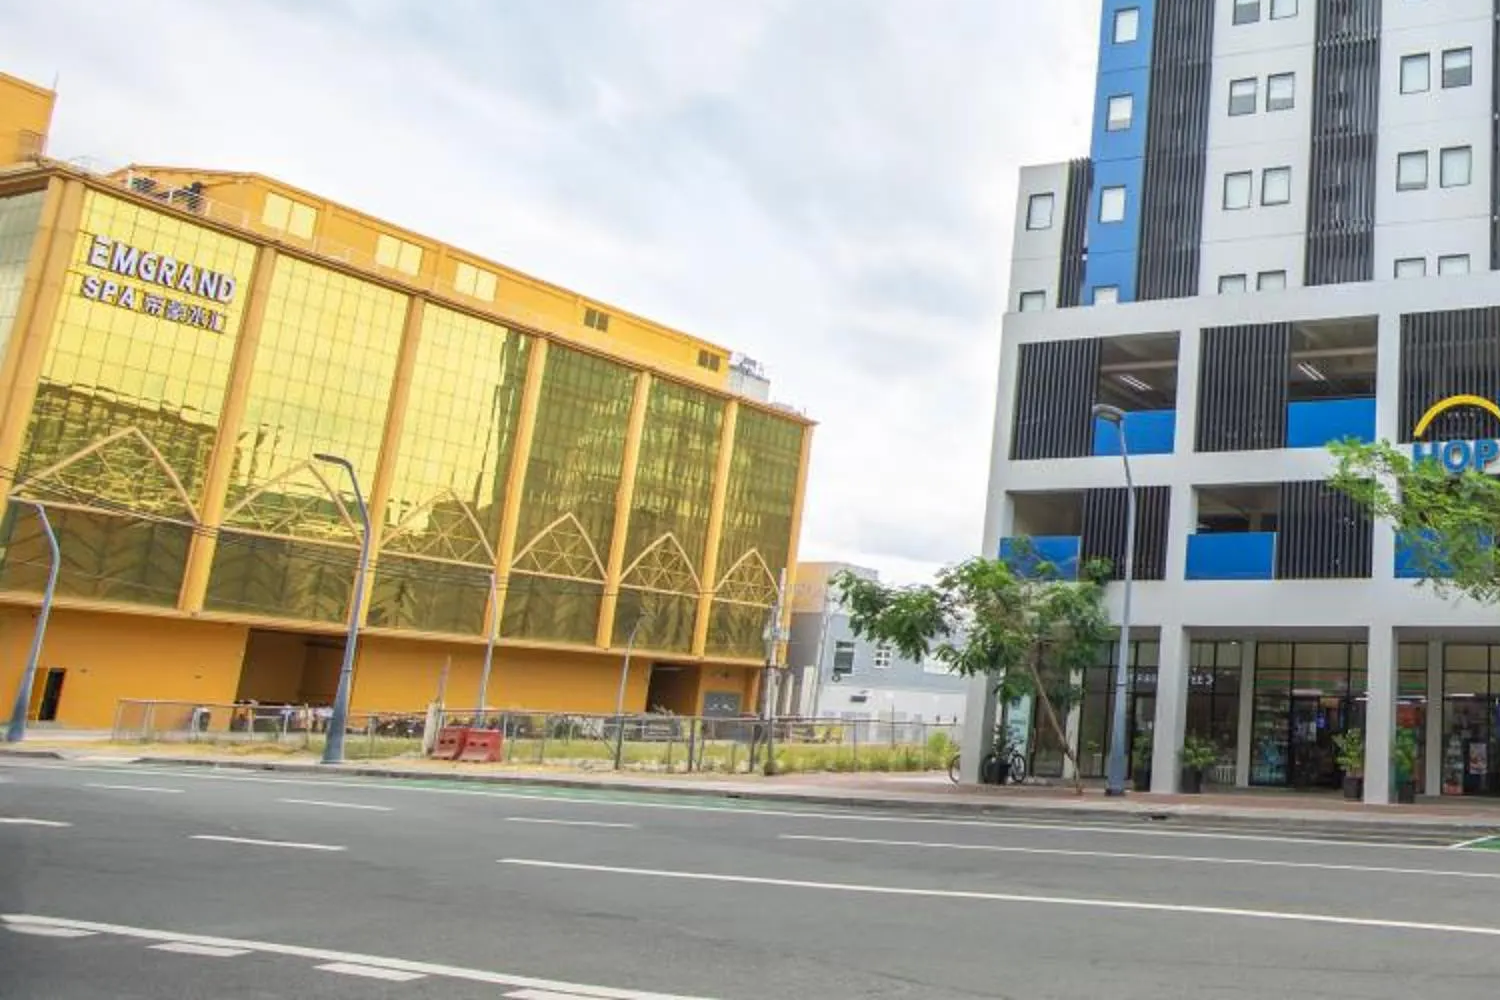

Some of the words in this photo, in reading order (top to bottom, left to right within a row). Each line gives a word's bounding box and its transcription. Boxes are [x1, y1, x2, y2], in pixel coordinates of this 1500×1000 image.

[88, 235, 236, 303] EMGRAND
[82, 275, 134, 309] SPA
[1412, 438, 1499, 473] HOP
